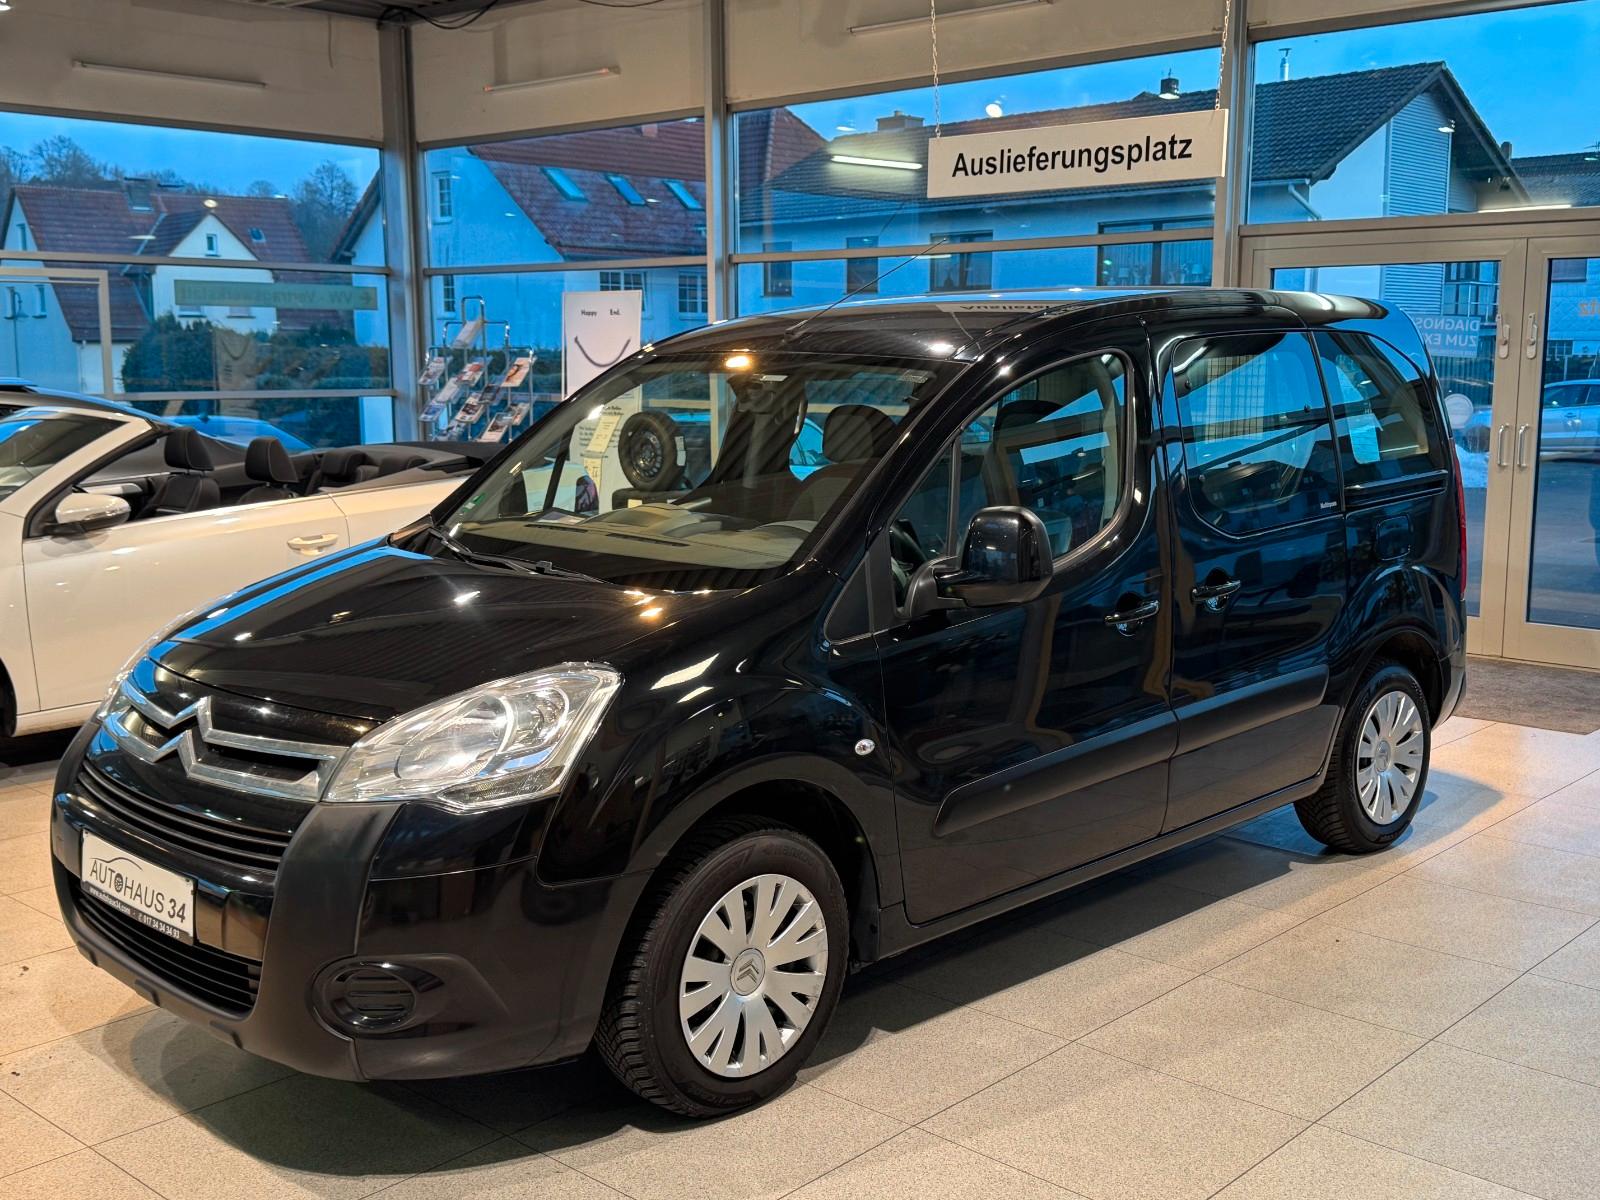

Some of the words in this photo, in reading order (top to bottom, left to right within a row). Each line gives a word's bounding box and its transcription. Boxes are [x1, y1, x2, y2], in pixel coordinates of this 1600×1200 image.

[952, 133, 1193, 177] Auslieferungsplatz
[580, 308, 598, 317] Happy
[89, 858, 165, 914] AUTOHAUS
[167, 898, 186, 924] 34
